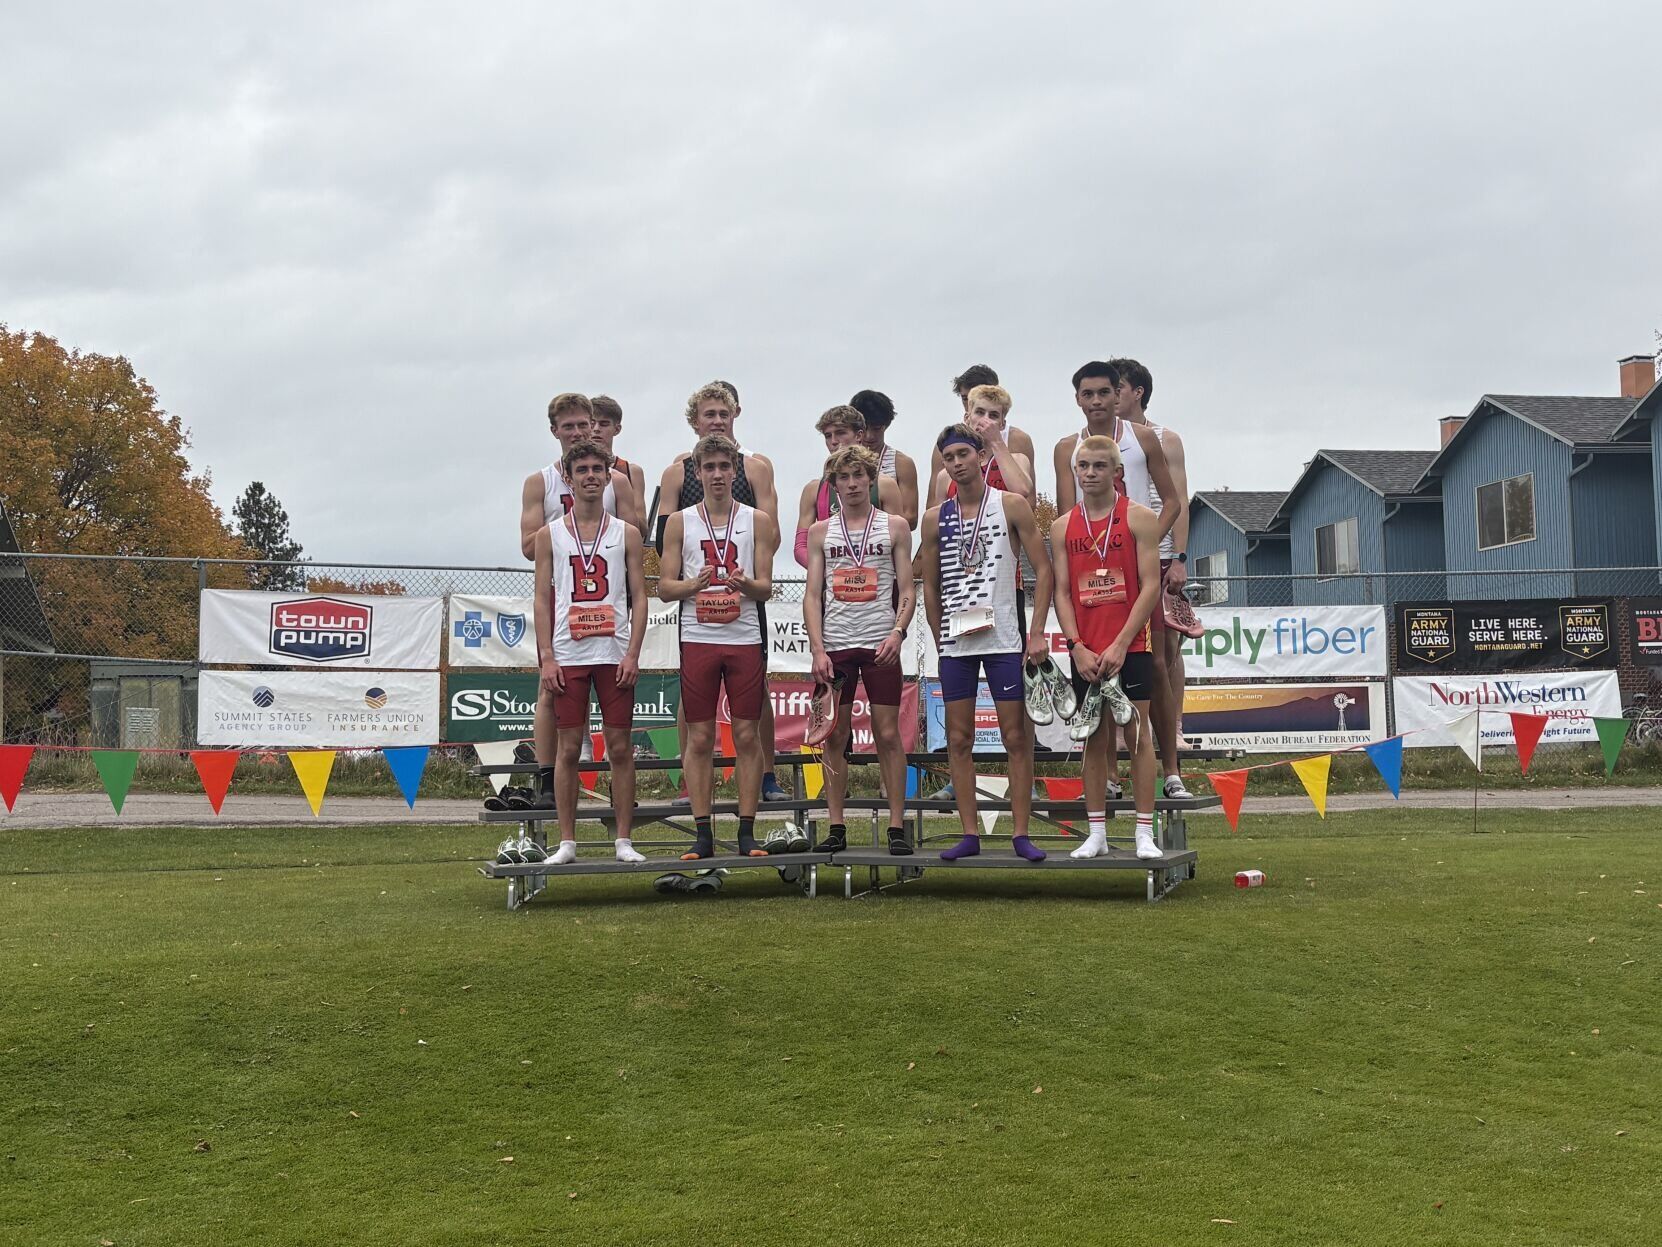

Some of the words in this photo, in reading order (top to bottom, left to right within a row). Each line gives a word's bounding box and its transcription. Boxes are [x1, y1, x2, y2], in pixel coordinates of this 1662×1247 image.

[569, 554, 609, 602] B
[1088, 577, 1116, 588] MILES
[701, 598, 736, 606] TAYLOR
[279, 610, 364, 628] town
[578, 614, 606, 622] MILES
[649, 614, 678, 625] ield
[1471, 618, 1501, 629] LIVE
[1508, 617, 1543, 629] HERE.
[1566, 616, 1601, 626] ARMY
[774, 622, 808, 635] WES
[1411, 619, 1448, 629] ARMY
[280, 631, 363, 649] pump
[1273, 617, 1375, 655] fiber
[1411, 636, 1450, 646] GUARD
[1468, 631, 1505, 642] SERVE
[1512, 630, 1548, 641] HERE.
[1566, 633, 1604, 642] GUARD
[1238, 693, 1264, 701] Country
[1427, 681, 1587, 706] NorthWestern
[633, 691, 673, 715] ank
[214, 712, 263, 722] SUMMIT
[270, 712, 312, 722] STATES
[327, 713, 381, 723] FARMERS
[387, 713, 424, 723] UNION
[1532, 704, 1589, 725] Energy
[219, 723, 263, 731] AGENCY
[269, 723, 307, 731] GROUP
[332, 724, 420, 732] INSURANCE
[1208, 736, 1251, 746] MONTANA
[1254, 735, 1279, 745] FARM
[1282, 735, 1316, 745] BUREAU
[1319, 734, 1371, 744] FEDERATION
